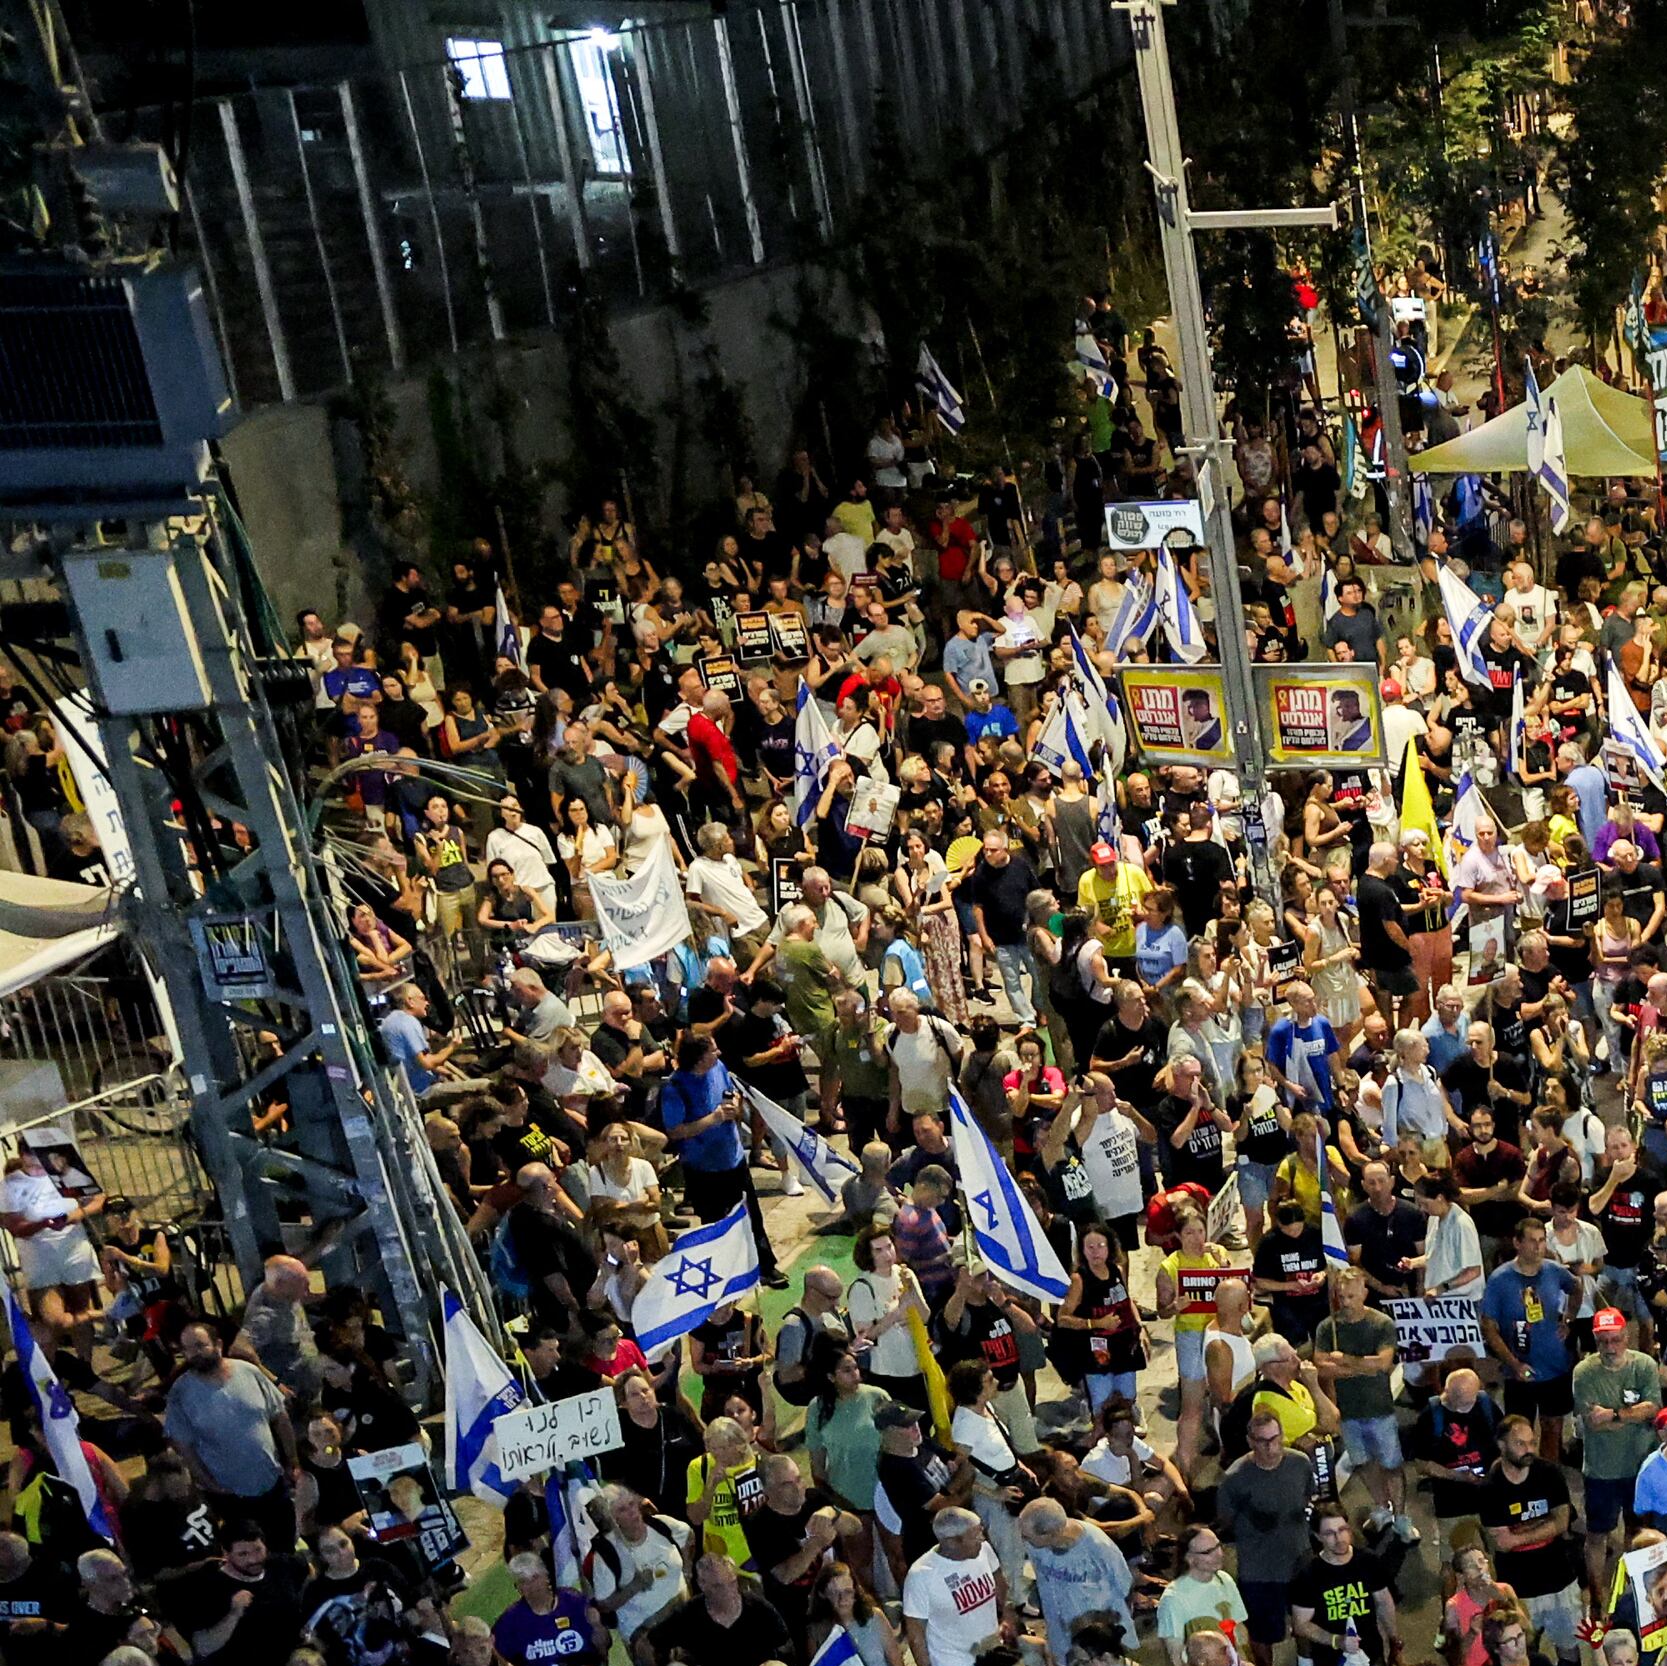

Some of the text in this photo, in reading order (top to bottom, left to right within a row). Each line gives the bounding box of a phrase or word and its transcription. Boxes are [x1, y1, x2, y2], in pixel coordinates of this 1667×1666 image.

[1141, 688, 1174, 710] מתן
[1289, 688, 1320, 709] מתן
[1173, 1276, 1206, 1288] BRING
[525, 1397, 602, 1430] תן לנו
[952, 1574, 995, 1610] NOW!
[1323, 1582, 1369, 1604] SEAL
[1327, 1599, 1370, 1621] DEAL
